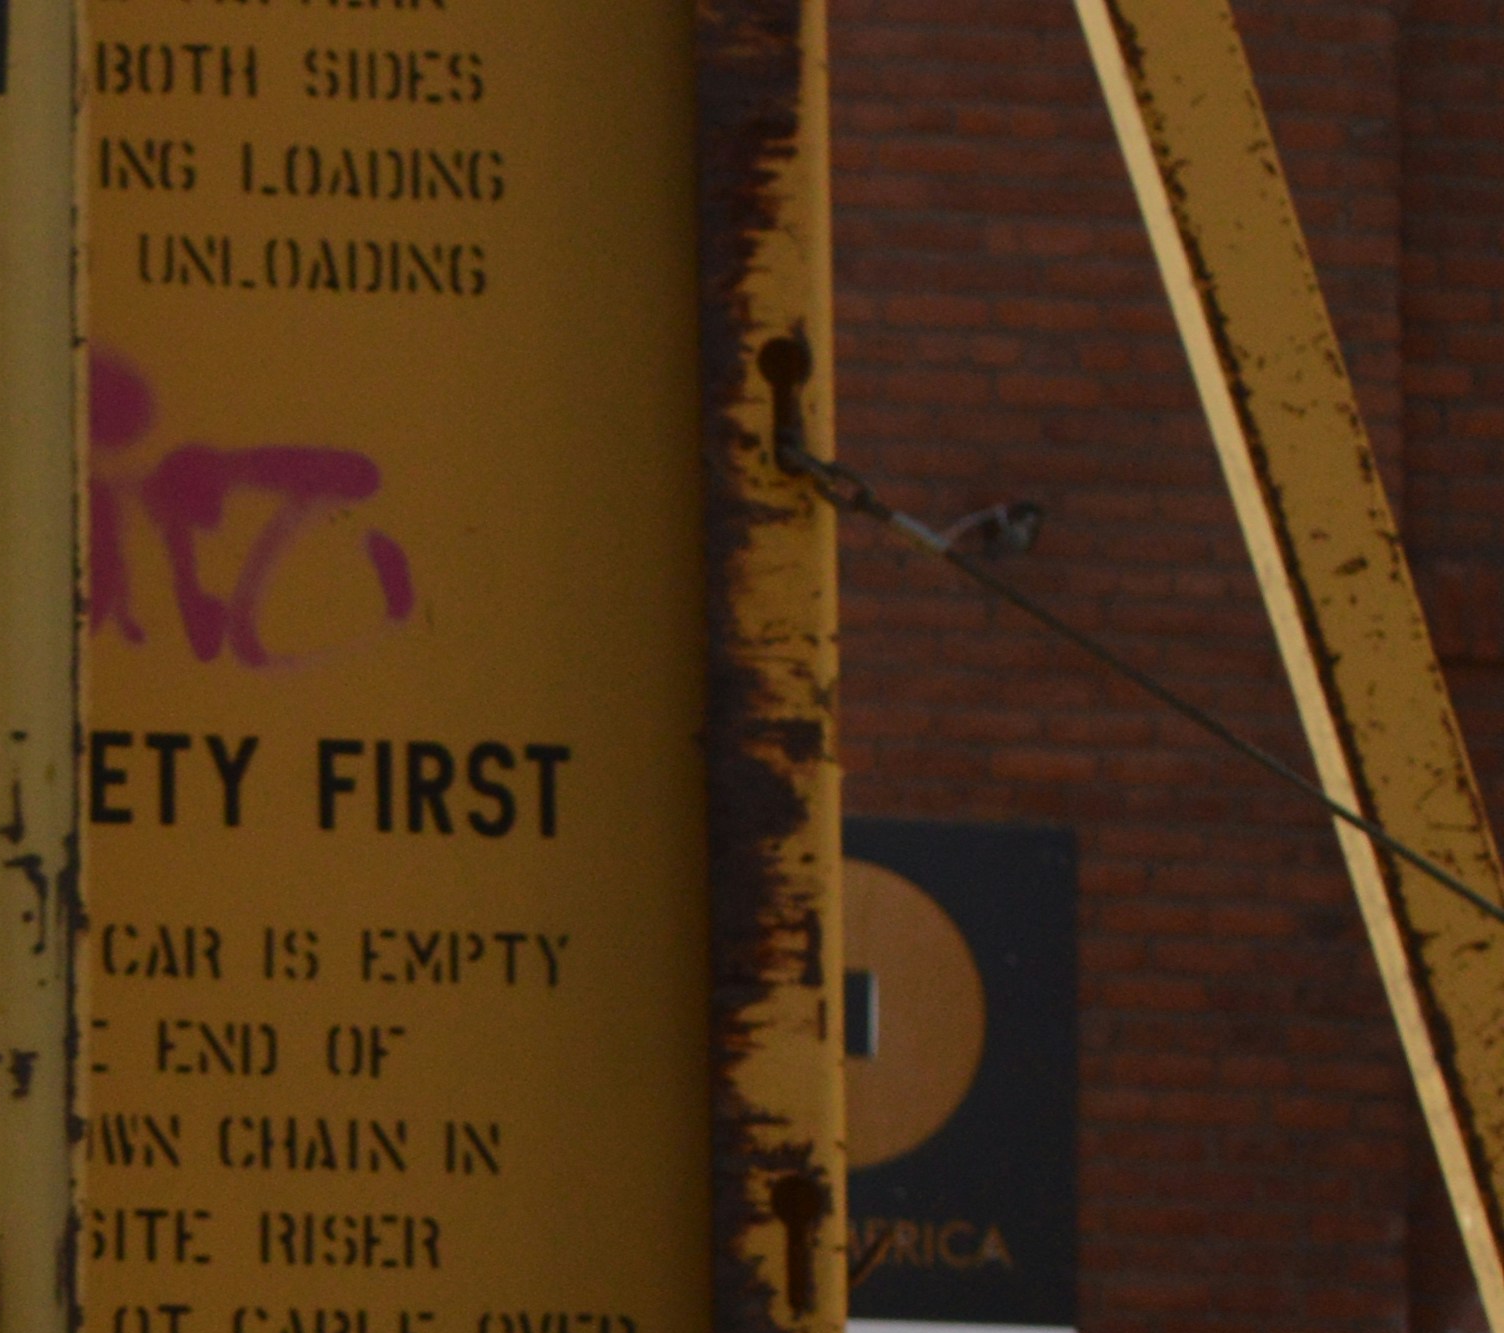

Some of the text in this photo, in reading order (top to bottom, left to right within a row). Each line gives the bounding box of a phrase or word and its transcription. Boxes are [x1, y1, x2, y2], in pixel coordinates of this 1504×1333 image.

[95, 41, 484, 105] BOTH SIDES
[241, 142, 505, 202] LOADING
[138, 233, 487, 297] UNLOADING
[89, 730, 572, 839] ETY FIRST
[101, 923, 570, 989] CAR IS EMPTY
[157, 1019, 278, 1077] END
[326, 1025, 406, 1079] OF
[86, 1110, 500, 1175] WN CHAIN IN
[259, 1211, 440, 1269] RISER
